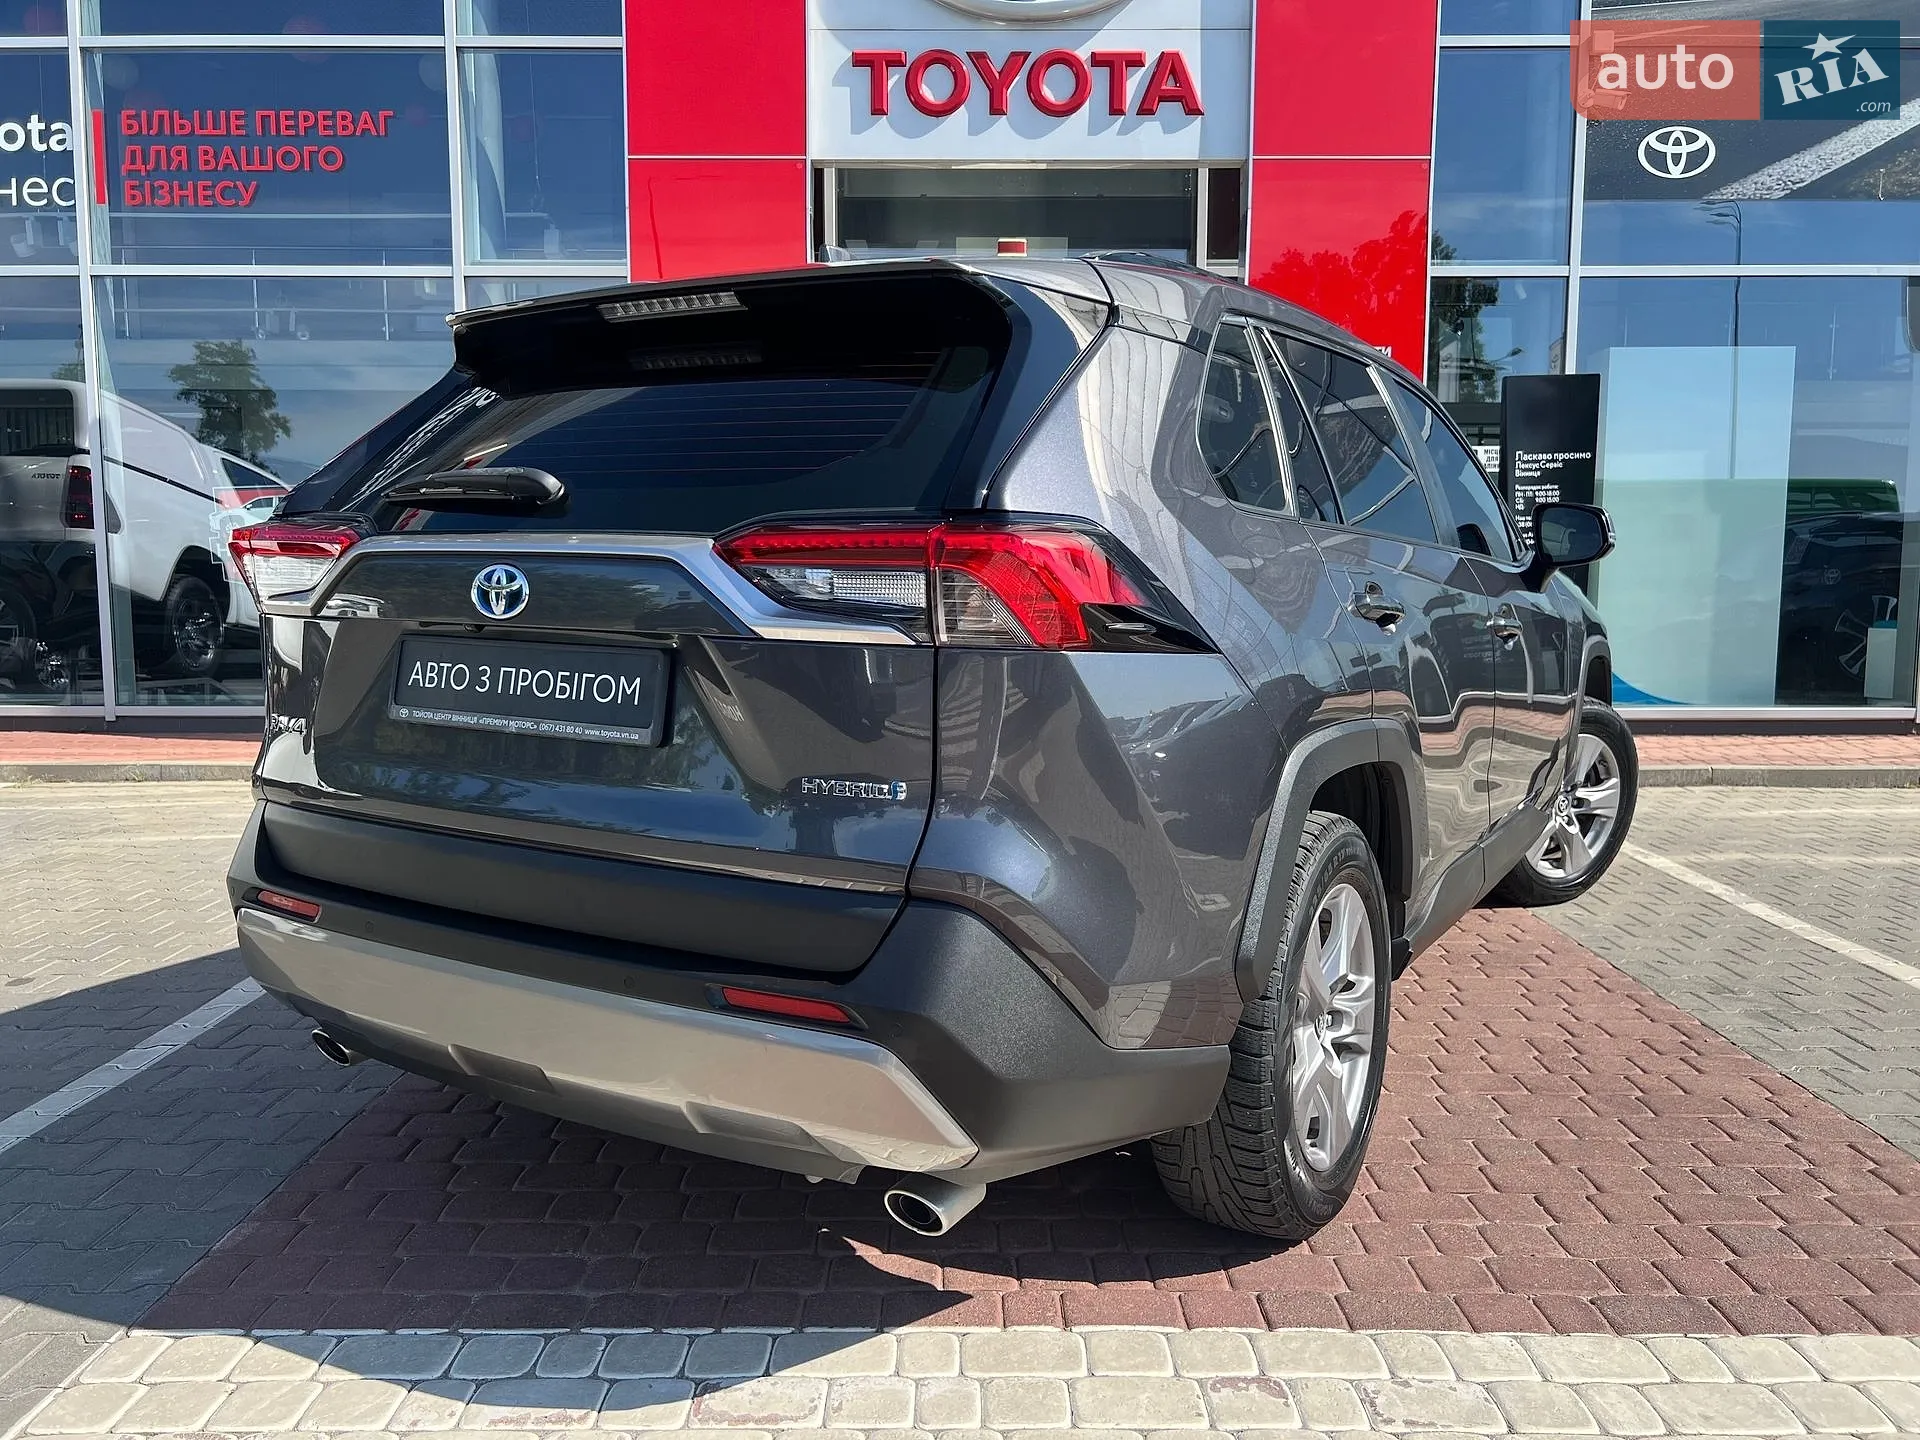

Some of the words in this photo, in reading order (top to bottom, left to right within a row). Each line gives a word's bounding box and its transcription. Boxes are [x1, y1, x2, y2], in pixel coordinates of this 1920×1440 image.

[852, 49, 1205, 117] TOYOTA
[121, 109, 246, 136] БІЛЬШЕ
[256, 109, 393, 136] ПЕРЕВАГ
[122, 145, 191, 174] ДЛЯ
[199, 145, 344, 171] ВАШОГО
[124, 180, 257, 207] БІЗНЕСУ
[1515, 450, 1553, 461] Ласкаво
[1554, 452, 1592, 461] просимо
[407, 661, 470, 691] АВТО
[475, 665, 491, 693] З
[497, 666, 641, 706] ПРОБІГОМ
[433, 712, 452, 720] ЦЕНТР
[539, 722, 555, 732] (067)
[555, 724, 566, 732] 431
[566, 725, 574, 733] 80
[575, 726, 583, 734] 40
[584, 728, 639, 739] www.toyota.vn.ua
[801, 777, 891, 799] HYBRID
